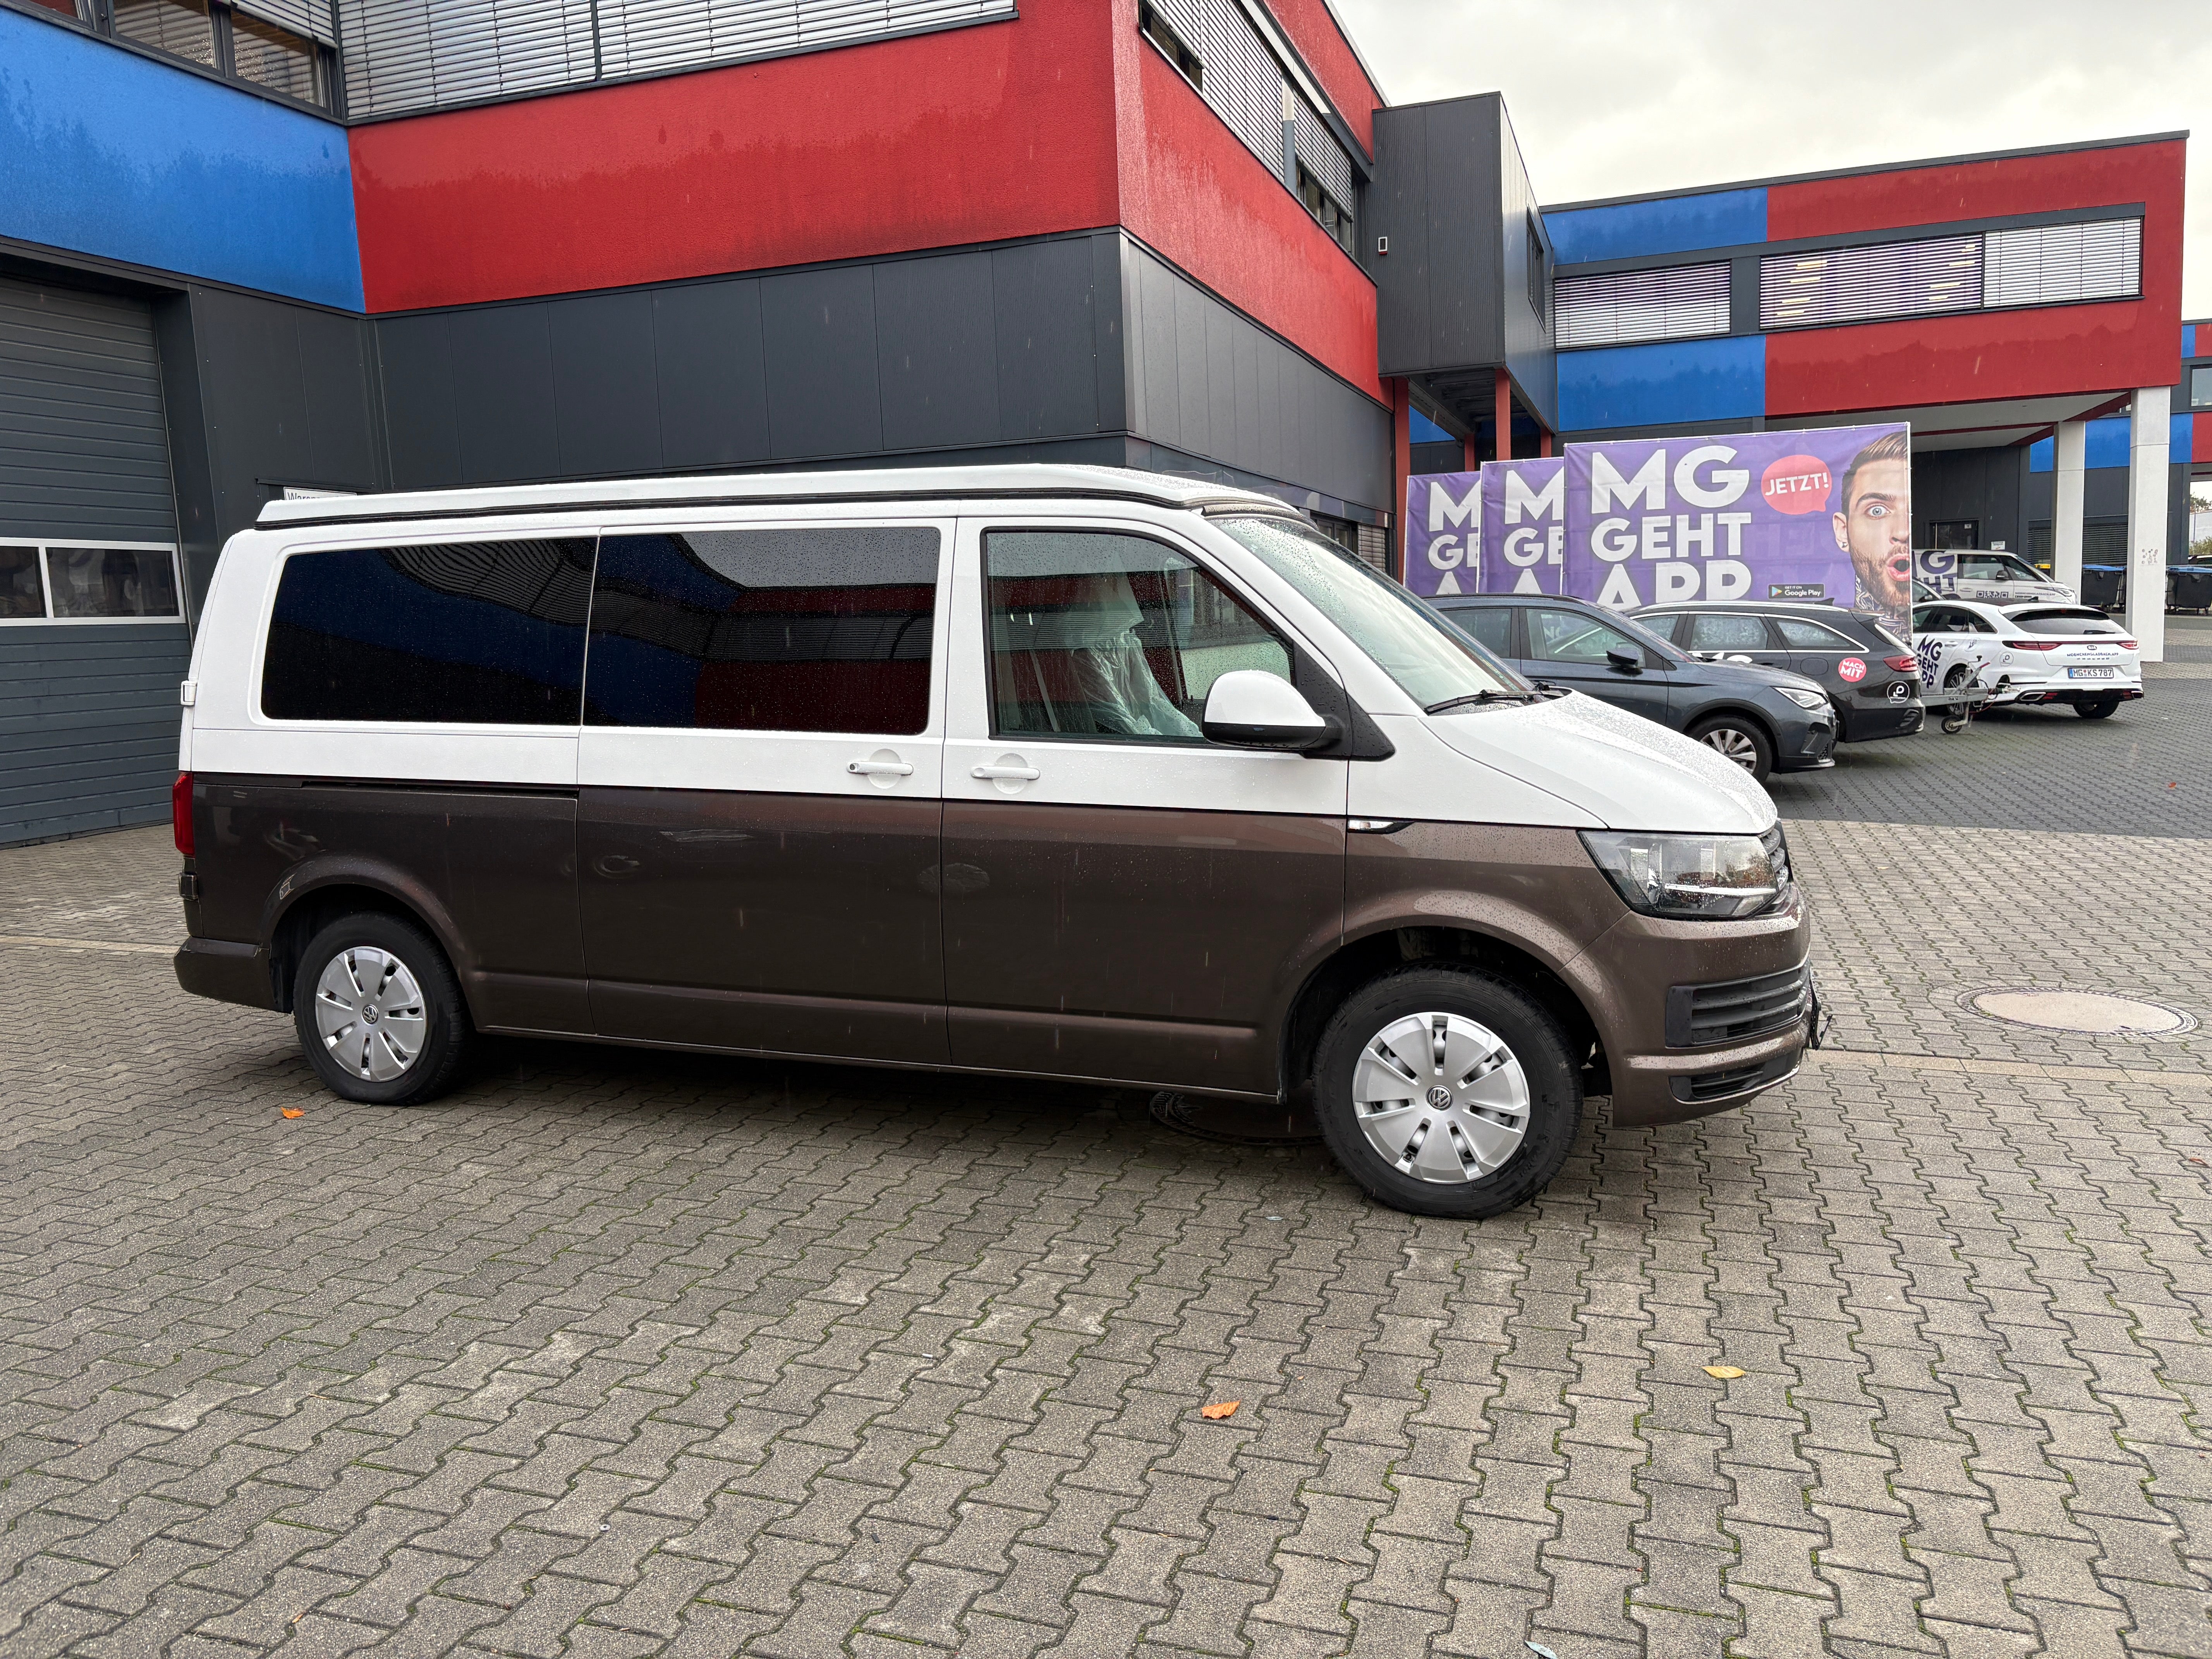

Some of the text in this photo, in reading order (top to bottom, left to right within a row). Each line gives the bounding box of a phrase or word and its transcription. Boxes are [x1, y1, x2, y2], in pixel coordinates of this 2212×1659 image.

[1591, 445, 1750, 514] MG
[1765, 472, 1829, 496] JETZT!
[1591, 512, 1751, 562] GEHT
[1917, 634, 1942, 661] MG
[1840, 665, 1863, 678] MIT
[1843, 659, 1865, 670] MACH
[1917, 653, 1939, 676] GEHT
